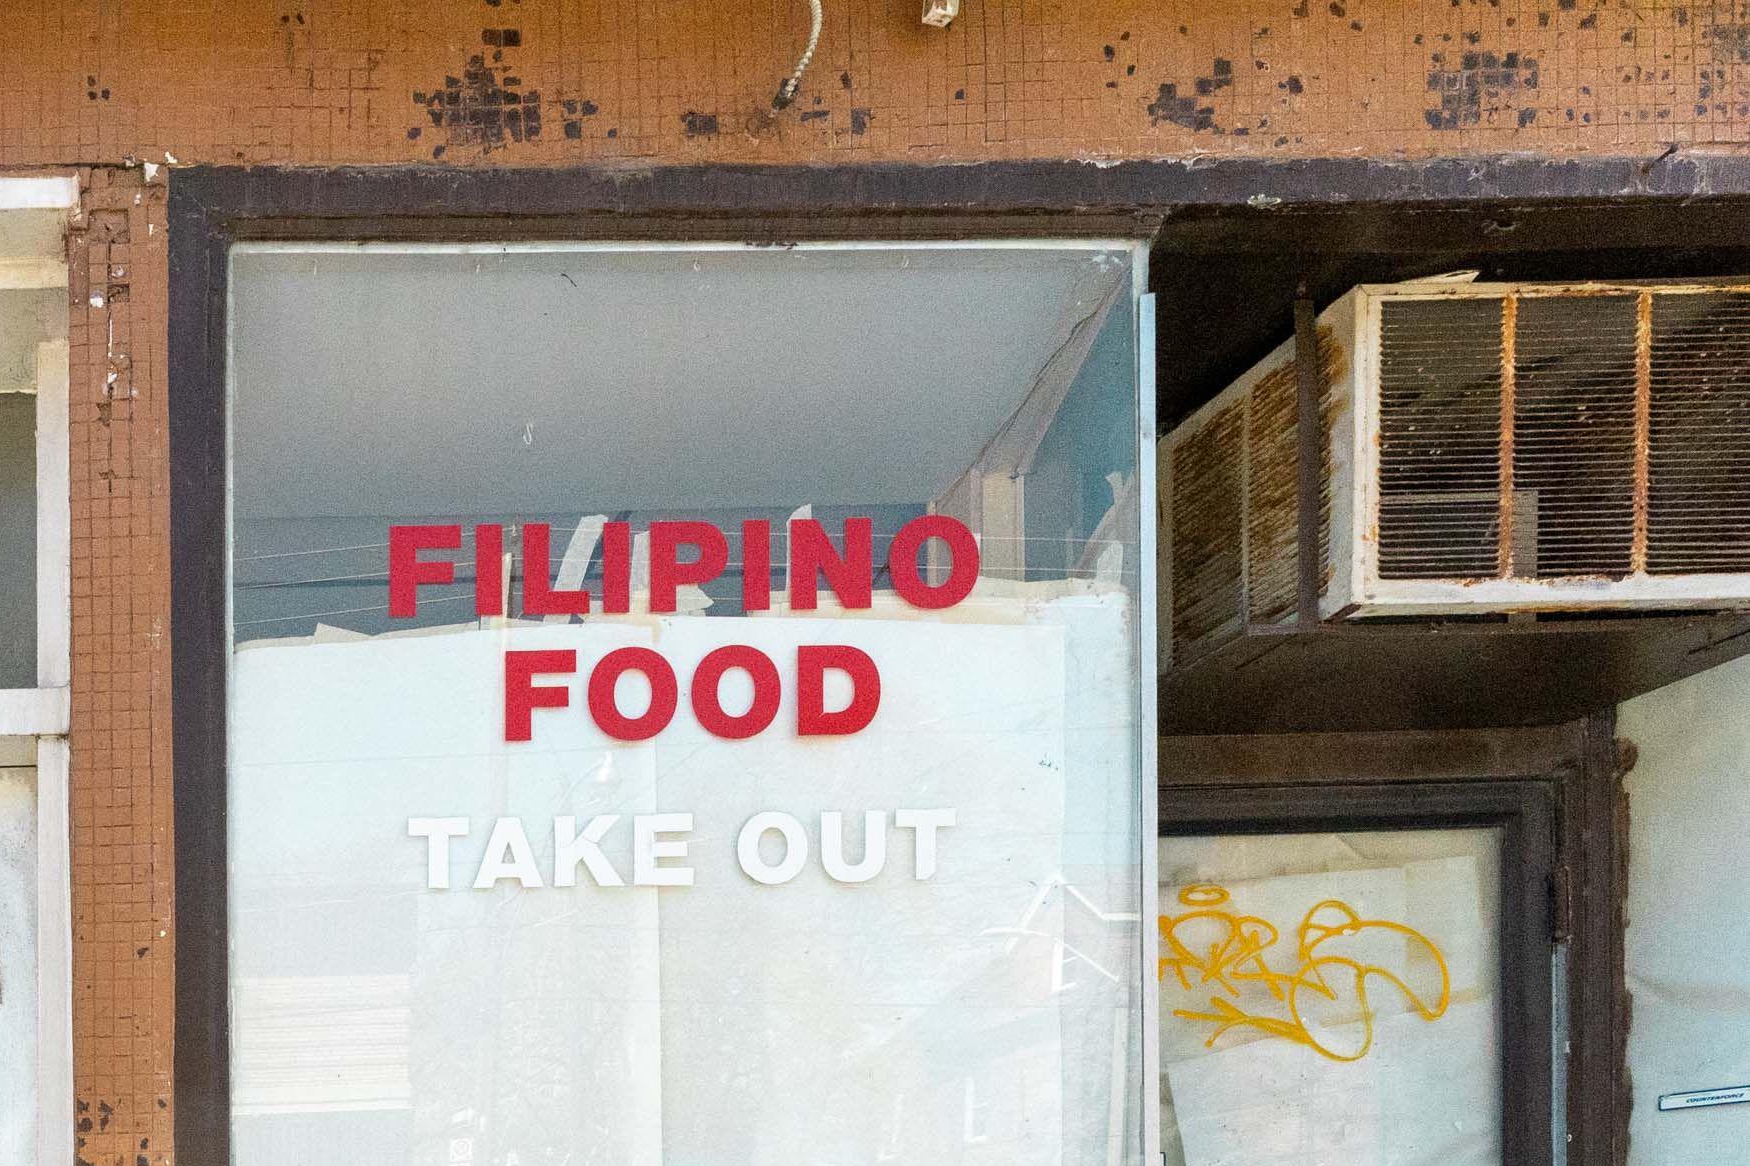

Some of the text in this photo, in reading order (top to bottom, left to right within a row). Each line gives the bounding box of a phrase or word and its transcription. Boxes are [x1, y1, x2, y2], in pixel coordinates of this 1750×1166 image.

[388, 514, 981, 618] FILIPINO
[504, 644, 882, 742] FOOD
[407, 807, 957, 890] TAKE OUT
